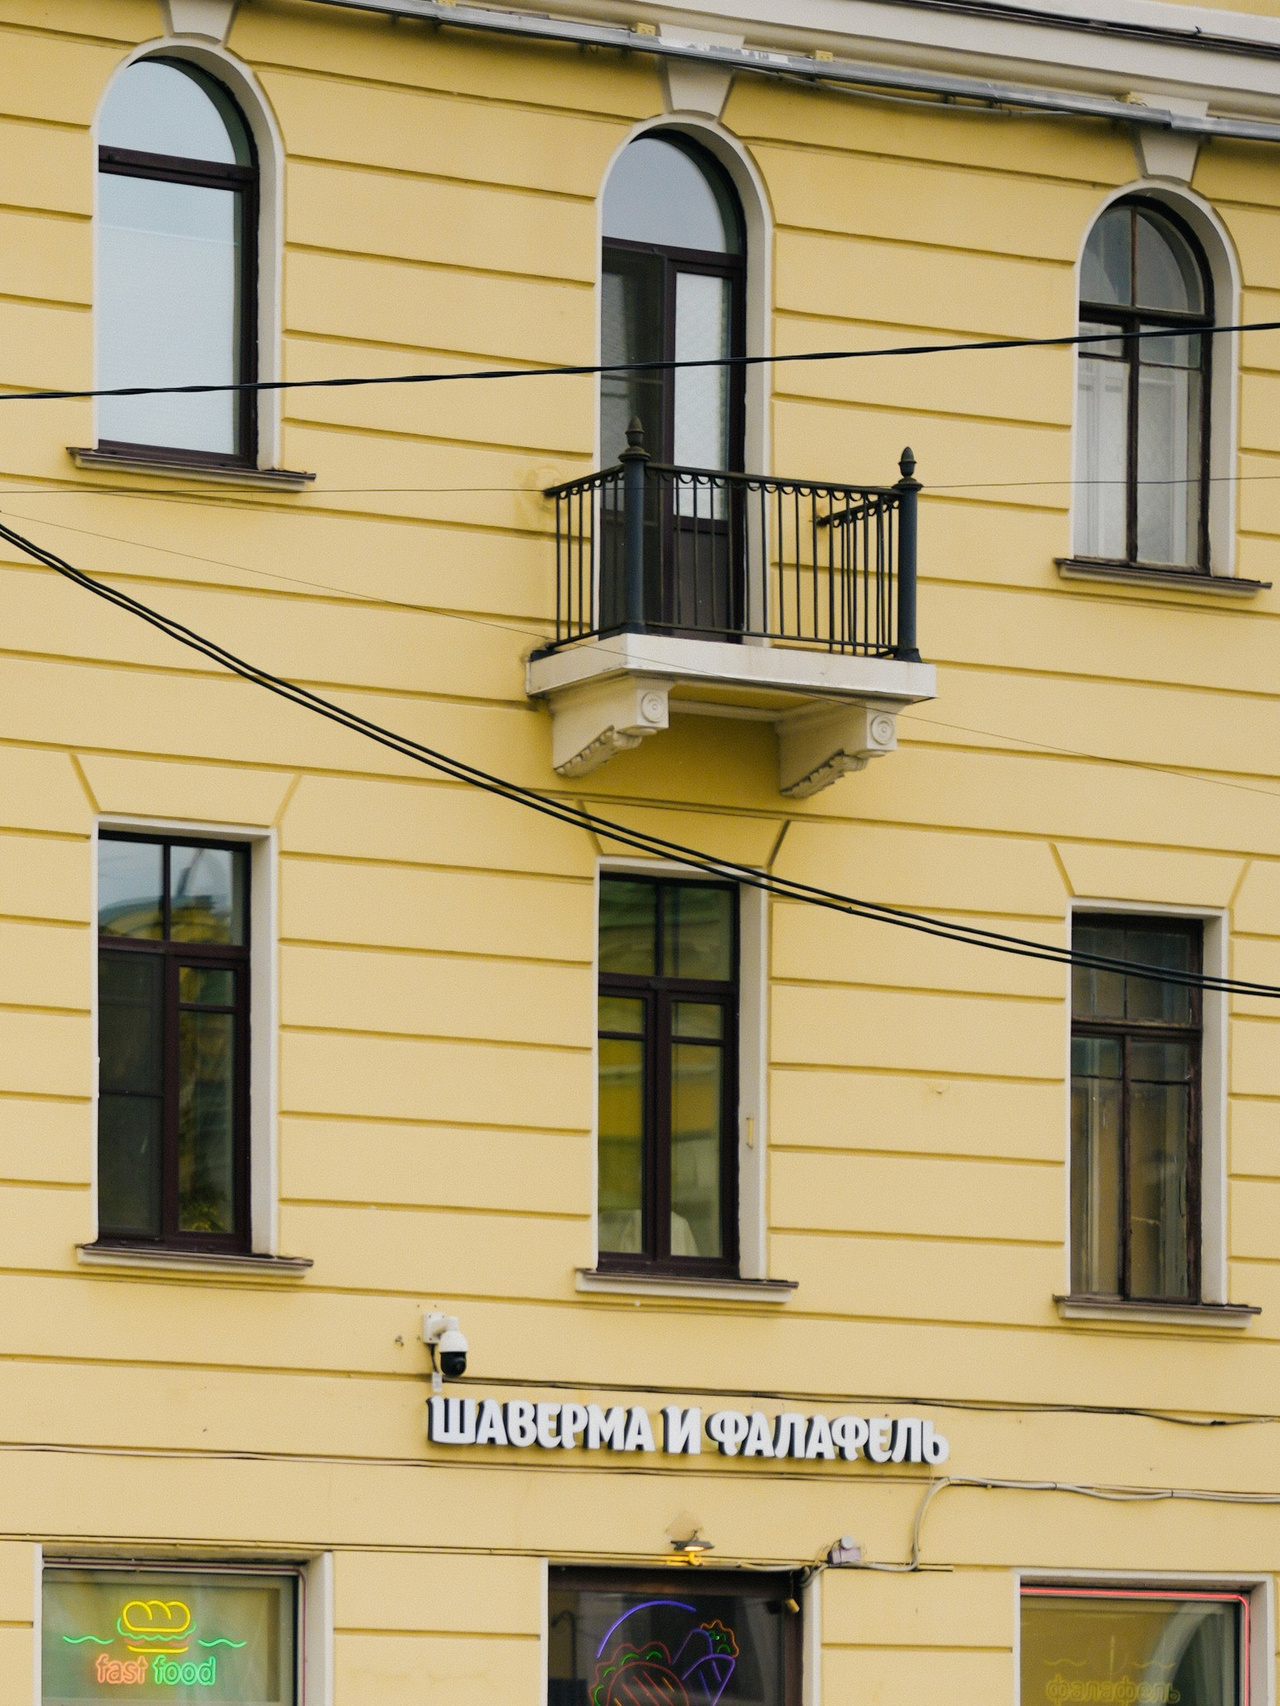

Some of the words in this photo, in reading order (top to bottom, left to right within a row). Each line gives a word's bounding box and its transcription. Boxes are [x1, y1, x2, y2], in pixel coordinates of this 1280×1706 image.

[426, 1395, 655, 1452] ШАВЕРМА
[661, 1405, 702, 1455] И
[706, 1410, 950, 1465] ФАЛАФЕЛЬ
[95, 1653, 149, 1685] fast
[153, 1654, 217, 1687] food
